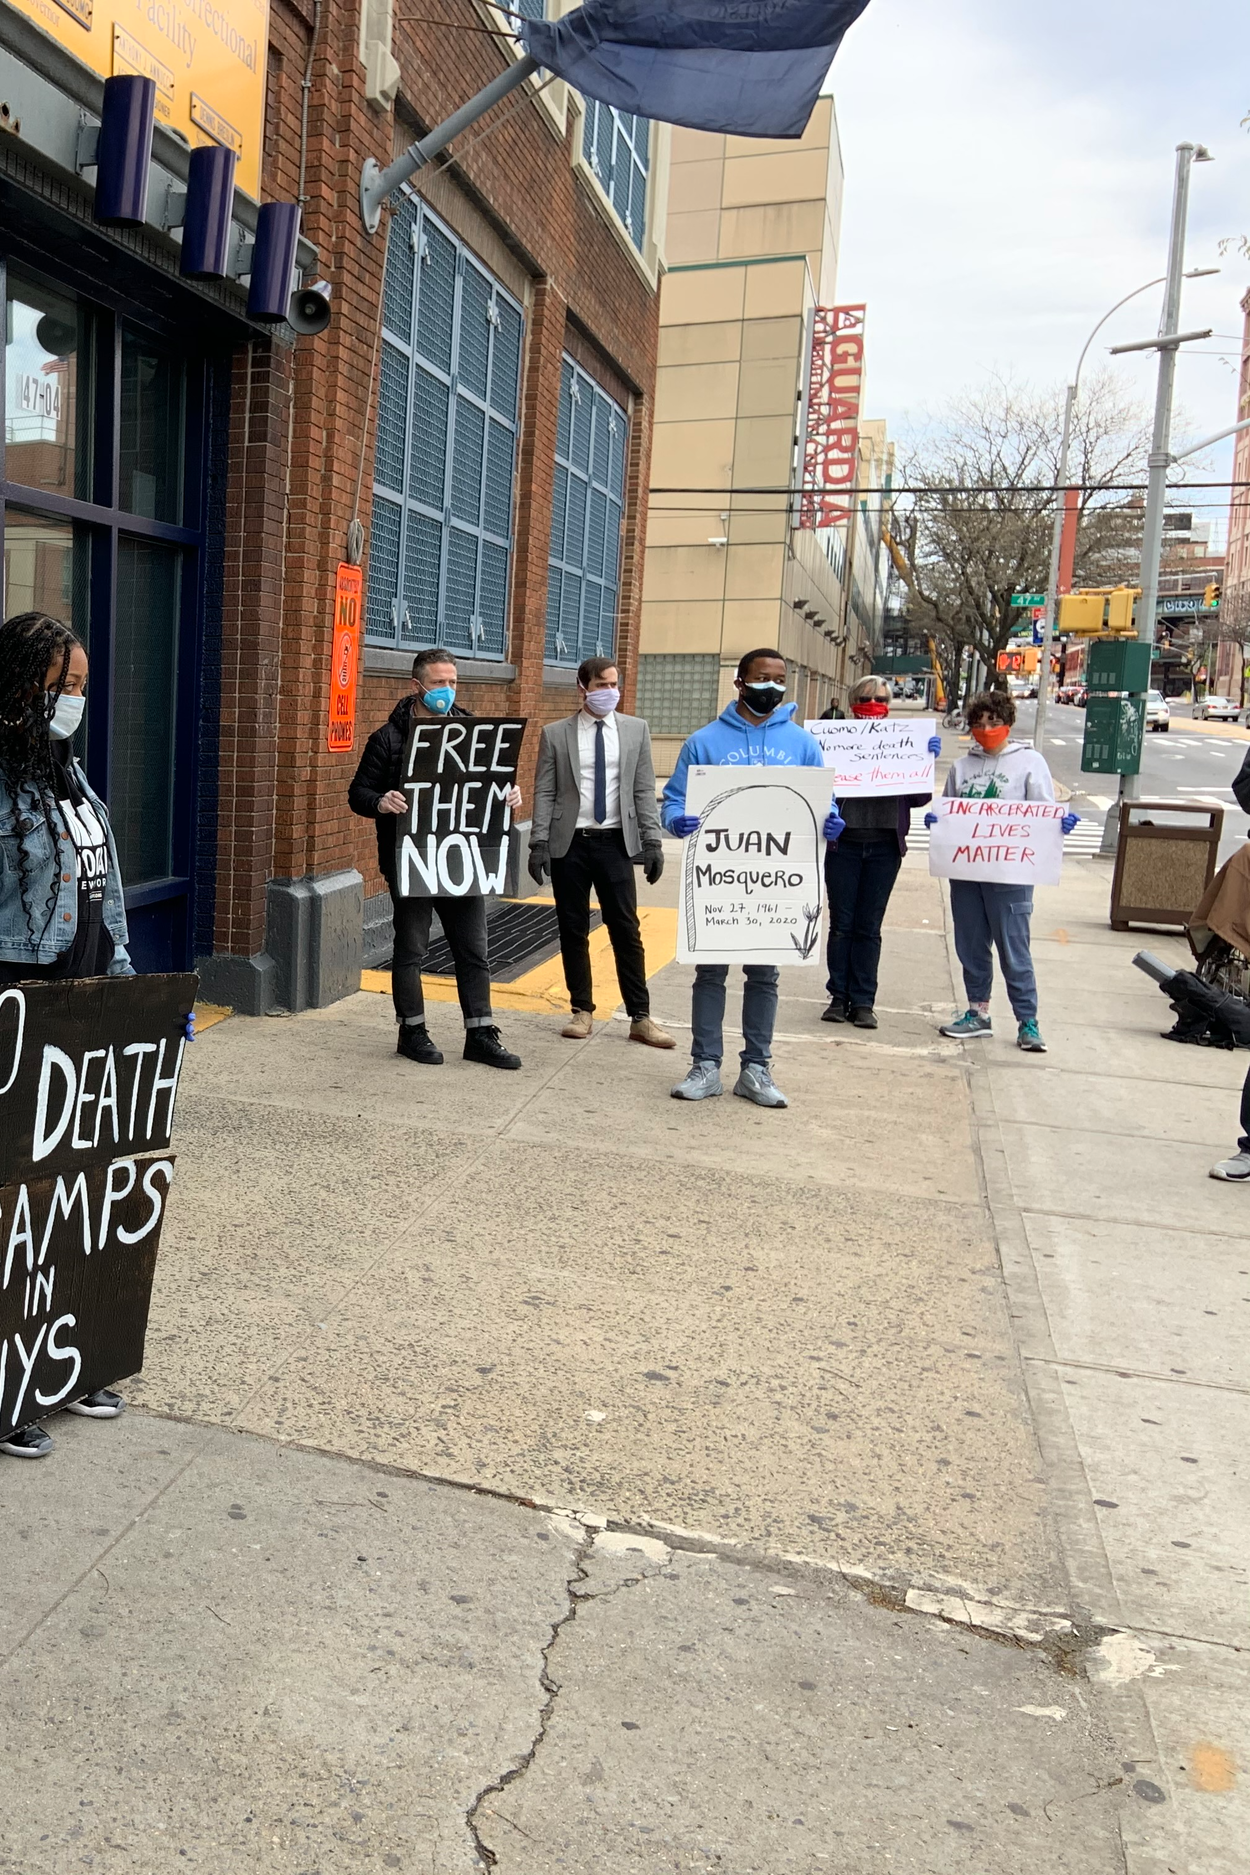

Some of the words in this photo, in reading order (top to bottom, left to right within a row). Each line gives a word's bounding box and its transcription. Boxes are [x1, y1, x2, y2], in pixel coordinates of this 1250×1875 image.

[23, 375, 60, 418] 47-04
[339, 595, 357, 627] NO
[407, 723, 523, 777] FREE
[872, 736, 914, 750] death
[719, 745, 794, 766] COLUMBI
[850, 750, 924, 762] sentences
[834, 772, 863, 782] ease
[866, 765, 905, 782] them
[909, 764, 933, 778] all
[404, 781, 511, 834] THEM
[942, 800, 1065, 819] INCARCERATED
[704, 828, 792, 856] JUAN
[972, 822, 1031, 839] LIVES
[401, 833, 509, 896] NOW
[952, 845, 1035, 866] MATTER
[769, 917, 797, 925] 2020
[32, 1036, 185, 1162] DEATH
[24, 1265, 55, 1320] IN
